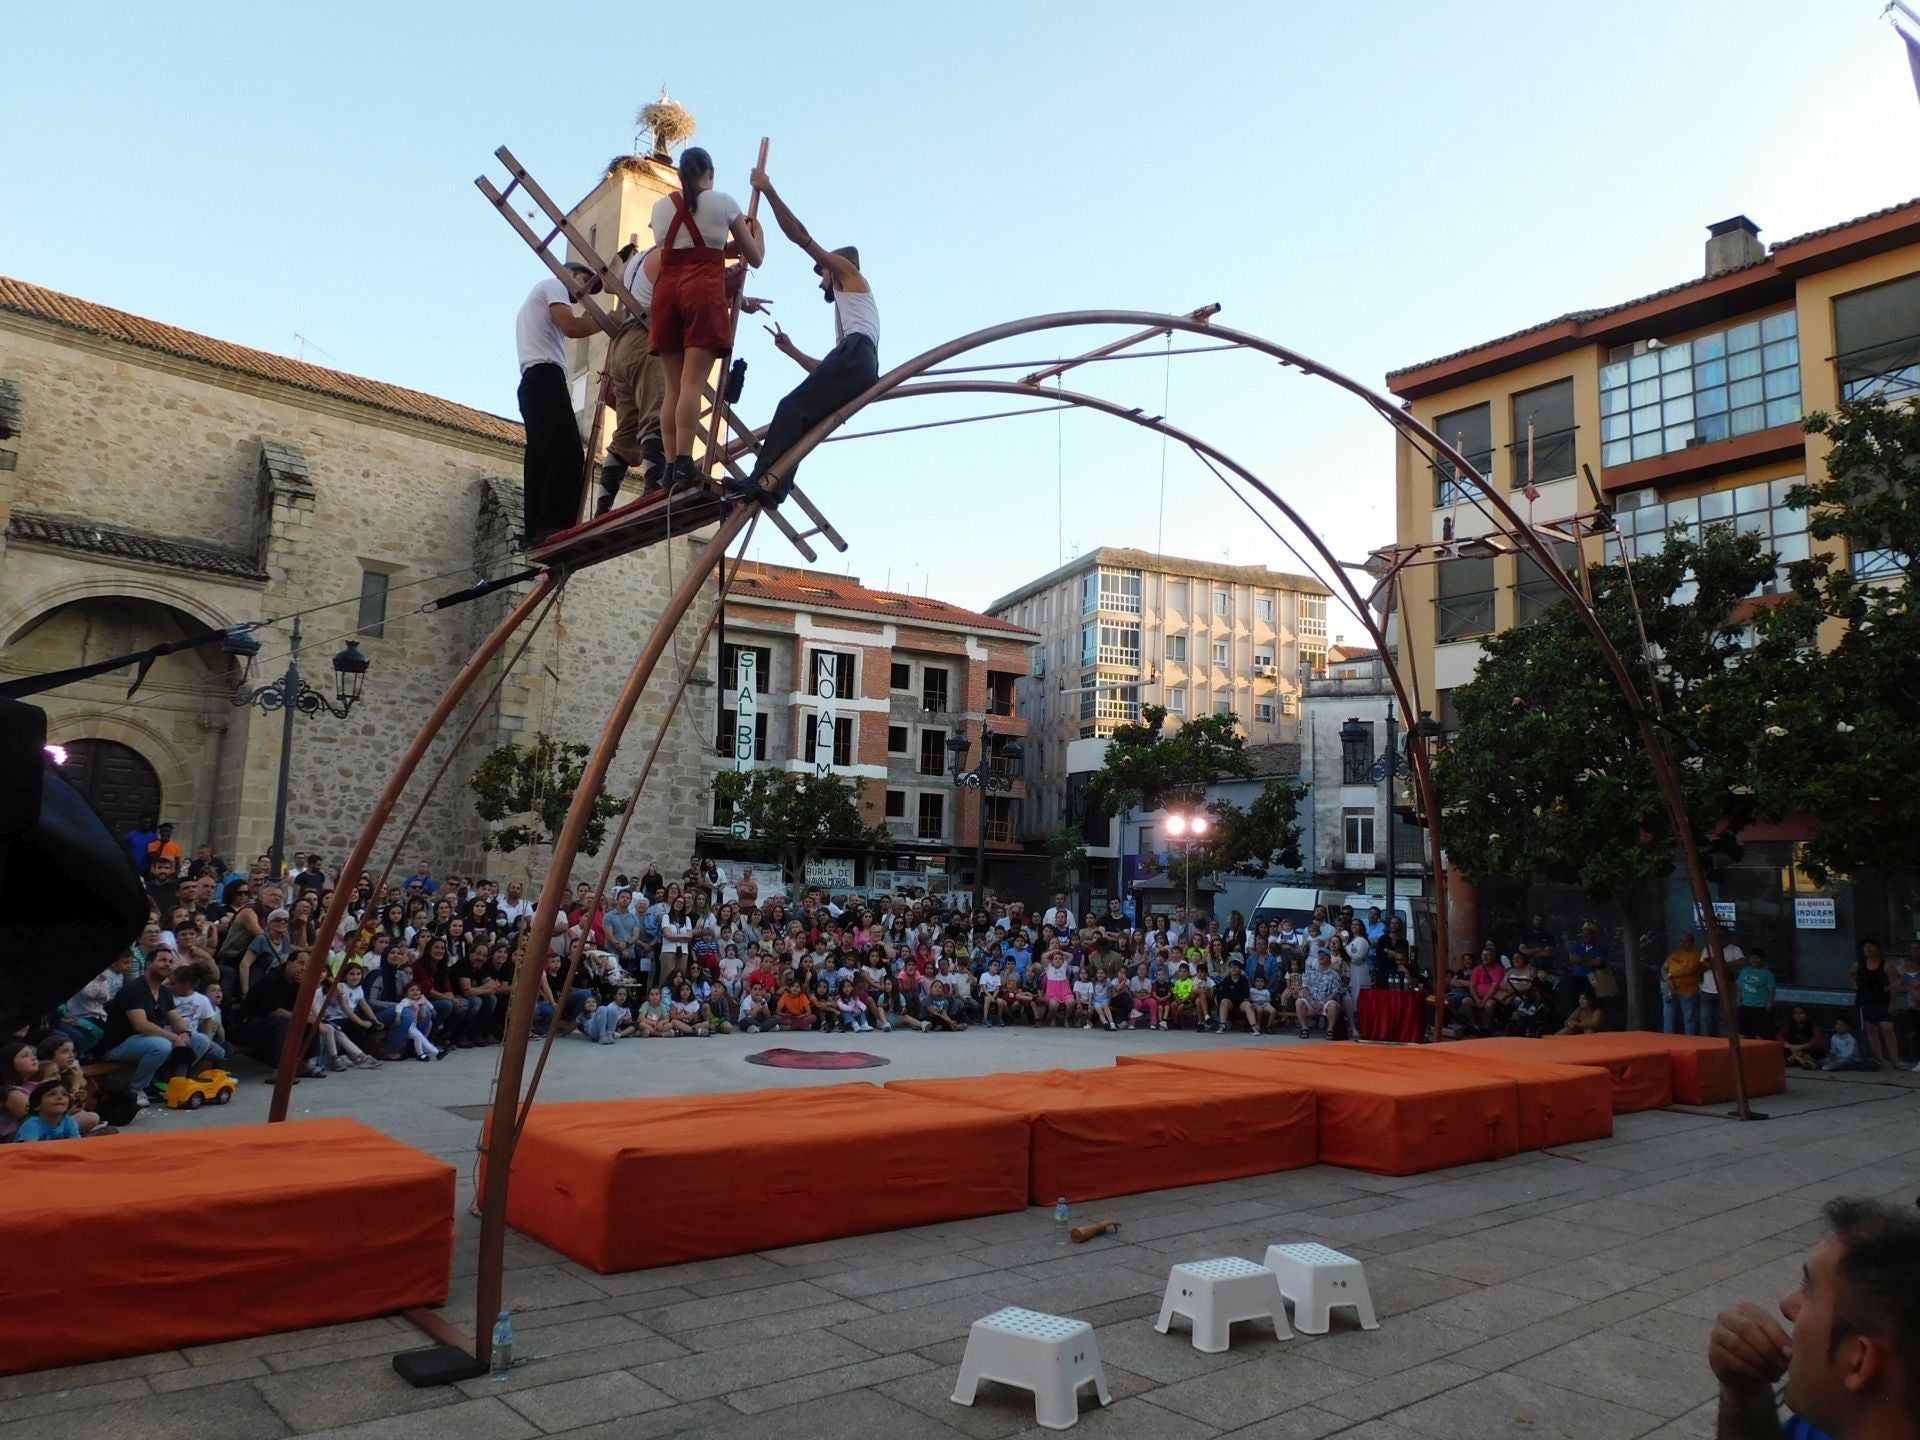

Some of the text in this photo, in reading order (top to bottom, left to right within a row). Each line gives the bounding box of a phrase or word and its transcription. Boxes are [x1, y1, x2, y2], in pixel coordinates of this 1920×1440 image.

[740, 652, 755, 682] SI
[818, 655, 835, 700] NO
[738, 686, 753, 717] AL
[817, 710, 834, 748] AL
[806, 868, 850, 877] BURLA DE
[835, 859, 847, 867] SE
